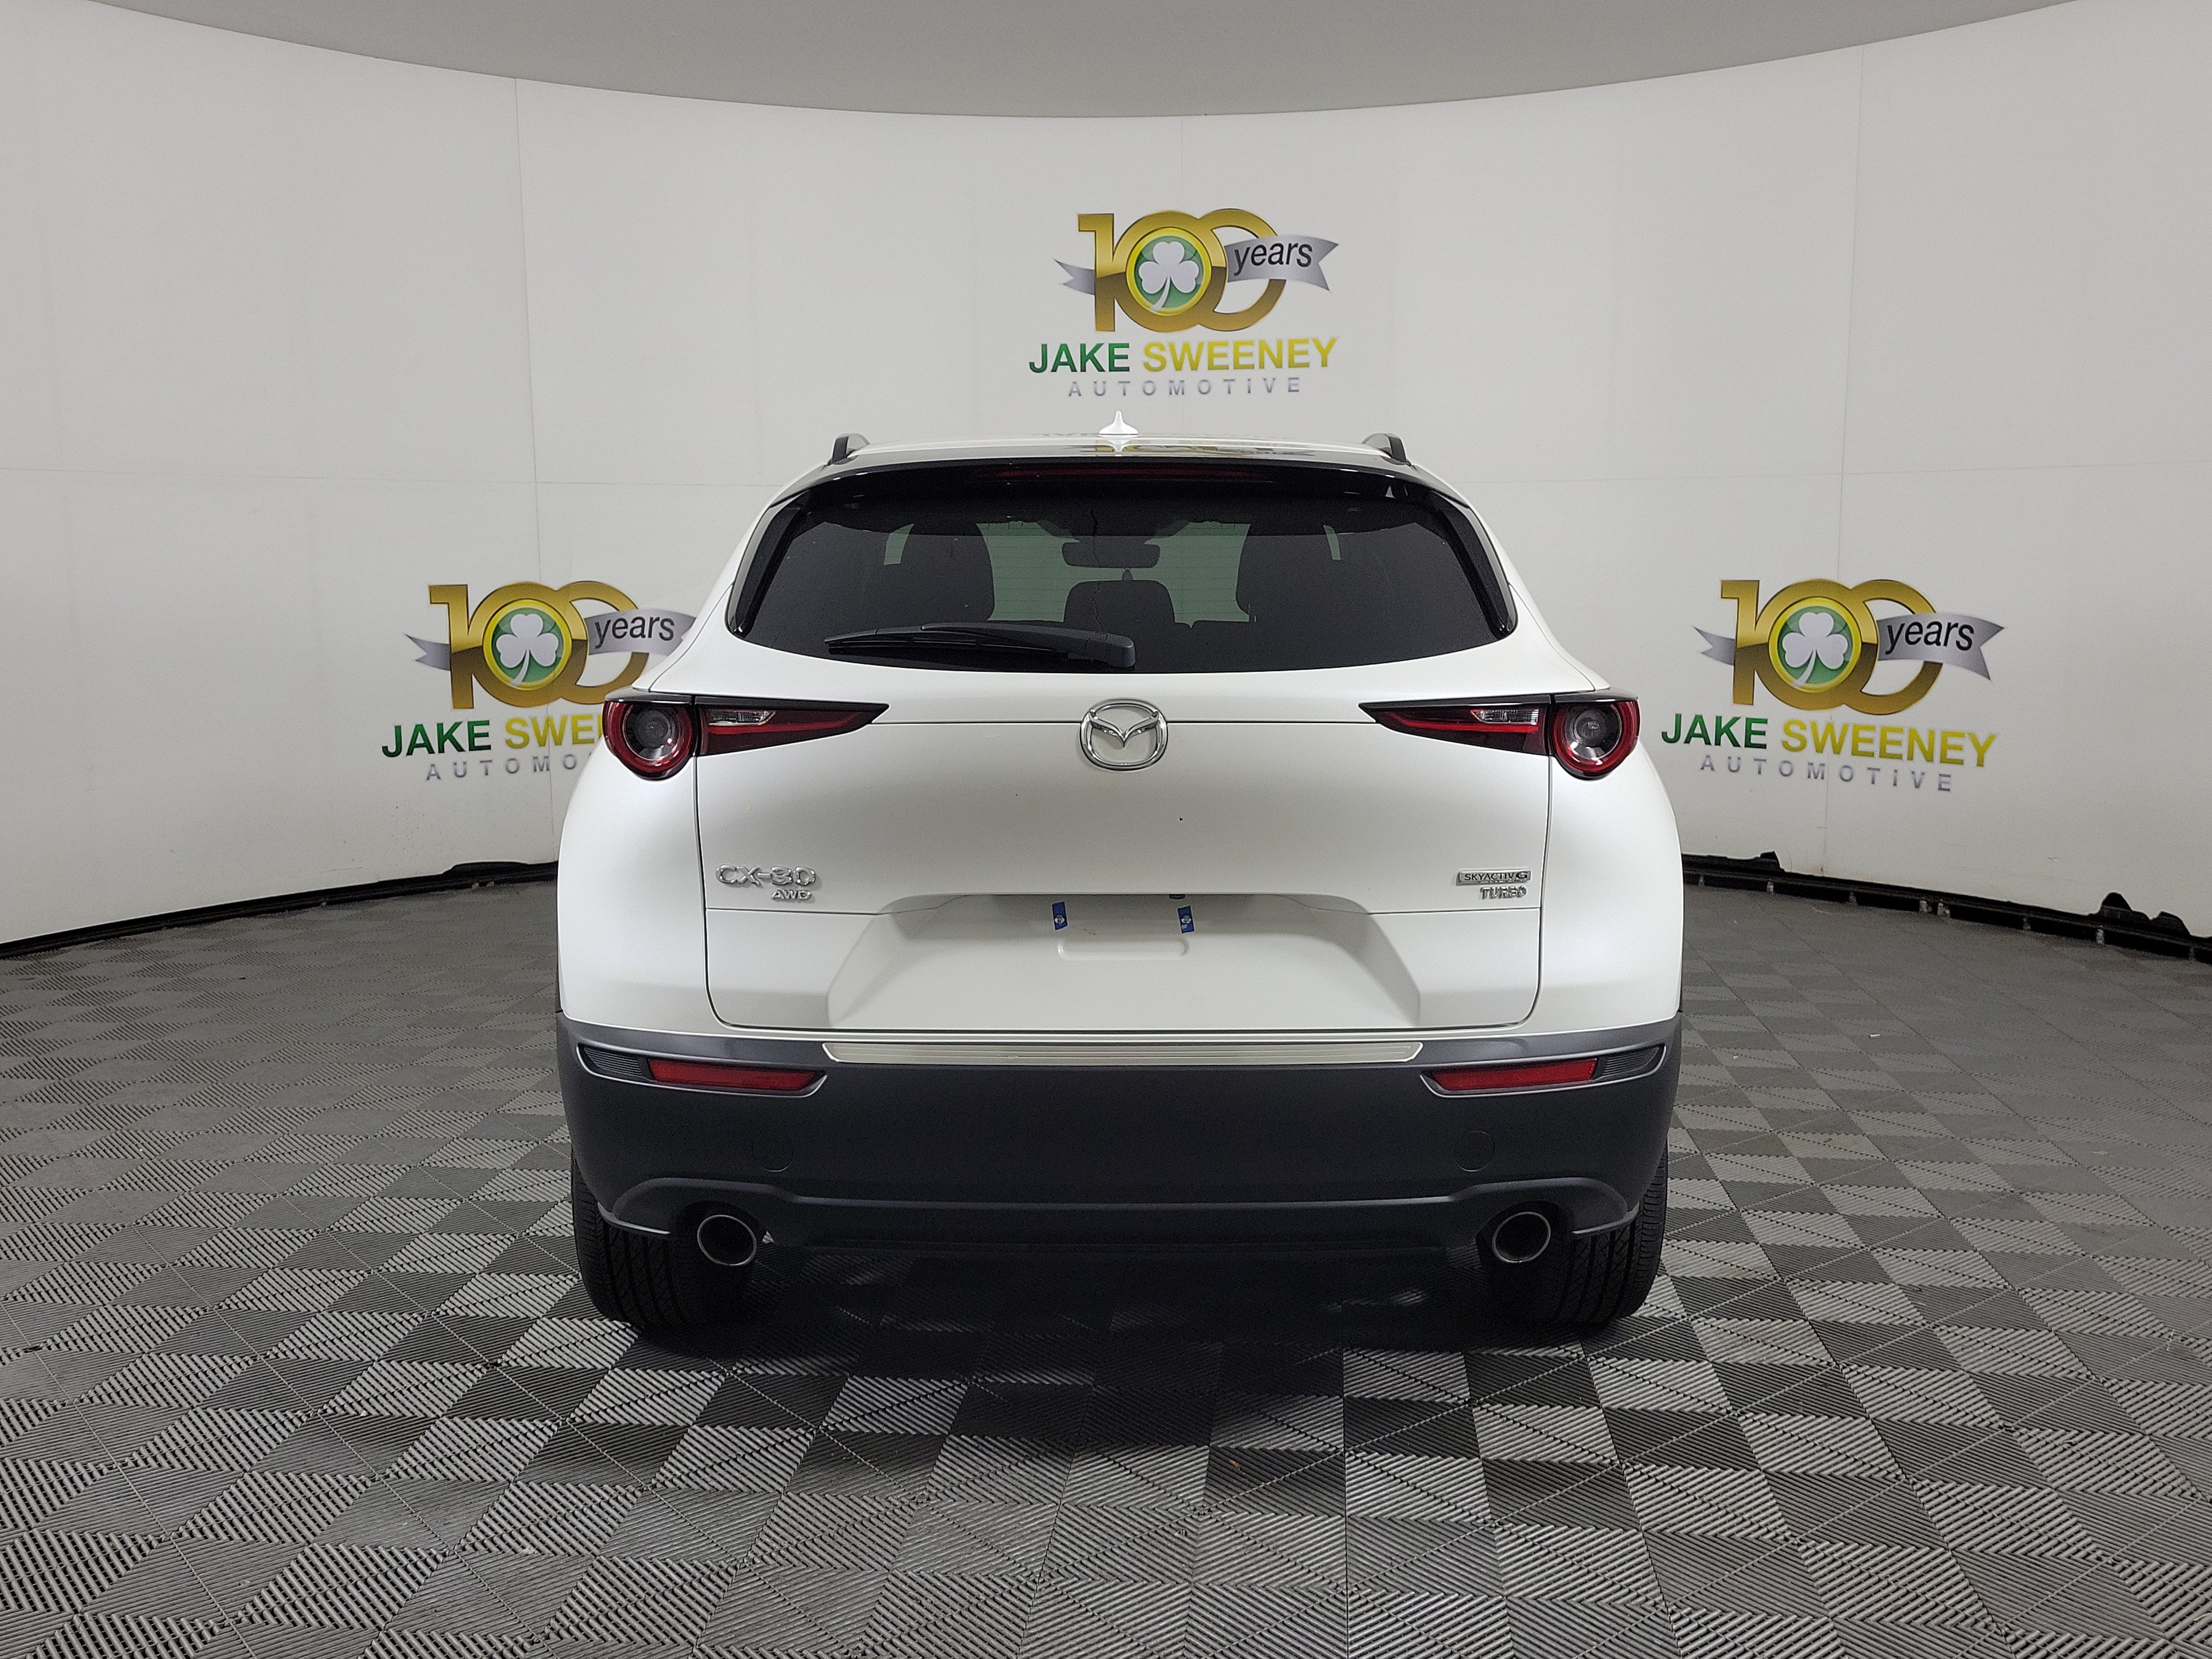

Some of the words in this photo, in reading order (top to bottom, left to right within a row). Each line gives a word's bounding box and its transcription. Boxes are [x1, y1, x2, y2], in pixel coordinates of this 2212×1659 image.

[1077, 208, 1286, 333] 100
[1234, 242, 1313, 276] years
[1029, 342, 1130, 374] JAKE
[1143, 337, 1338, 373] SWEENEY
[1068, 377, 1300, 397] AUTOMOTIVE
[428, 580, 650, 709] 100
[595, 616, 675, 648] years
[1720, 578, 1943, 715] 100
[1885, 620, 1975, 655] years
[382, 720, 492, 757] JAKE
[1661, 713, 1768, 749] JAKE
[1781, 719, 1996, 768] SWEENEY
[426, 752, 591, 781] AUTOMO
[1700, 754, 1953, 792] AUTOMOTIVE
[715, 864, 816, 888] CX-30
[1480, 885, 1528, 900] TURBO
[771, 889, 812, 901] AWD
